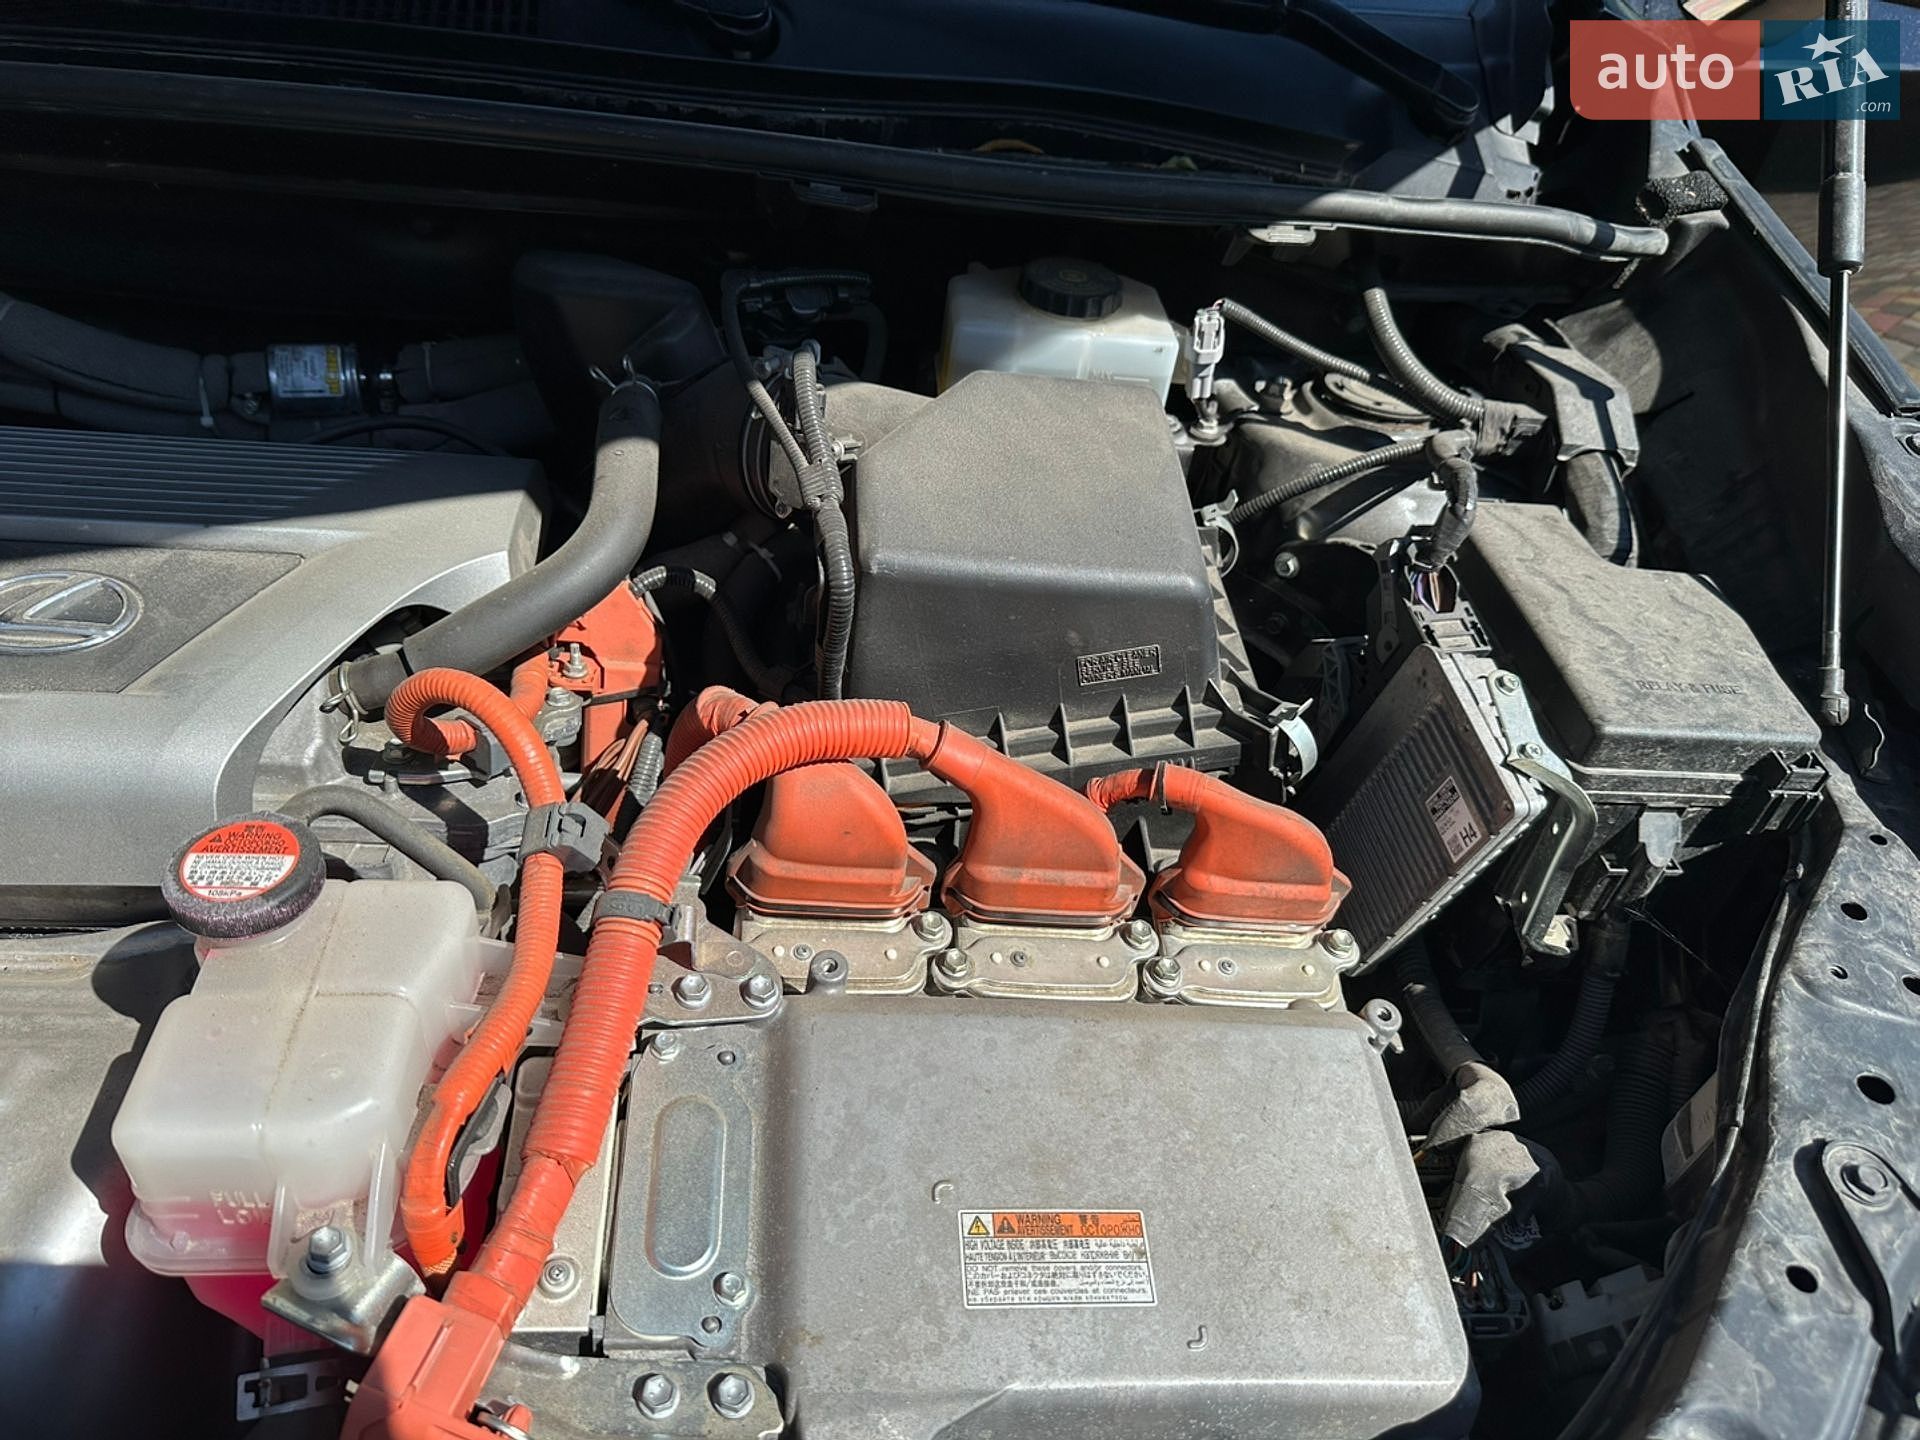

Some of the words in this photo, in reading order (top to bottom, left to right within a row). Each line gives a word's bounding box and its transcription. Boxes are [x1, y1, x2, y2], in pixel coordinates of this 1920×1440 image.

[1636, 680, 1684, 693] RELAY
[1701, 683, 1745, 695] FUSE
[228, 831, 284, 842] WARNING
[1460, 821, 1478, 848] H4
[201, 845, 289, 855] AVERTISSEMENT
[1017, 1214, 1061, 1225] WARNING
[1017, 1225, 1073, 1236] AVERTISSEMENT
